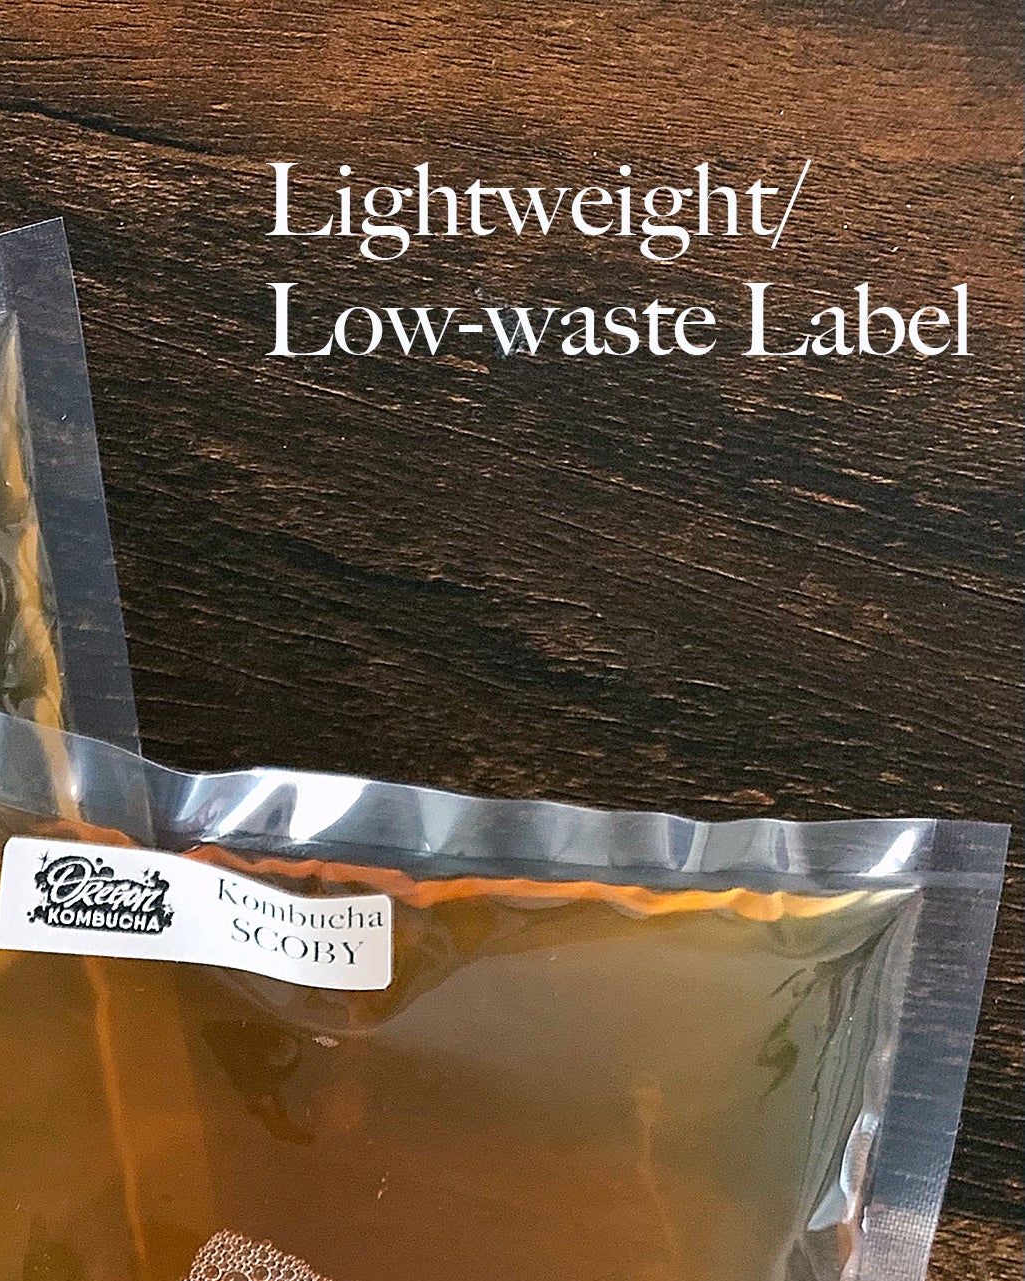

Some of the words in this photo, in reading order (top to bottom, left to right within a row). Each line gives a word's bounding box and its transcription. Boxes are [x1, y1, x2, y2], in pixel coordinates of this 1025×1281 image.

[47, 907, 161, 933] KOMBUCHA
[218, 877, 384, 930] Kombucha
[231, 917, 364, 966] SCOBY
